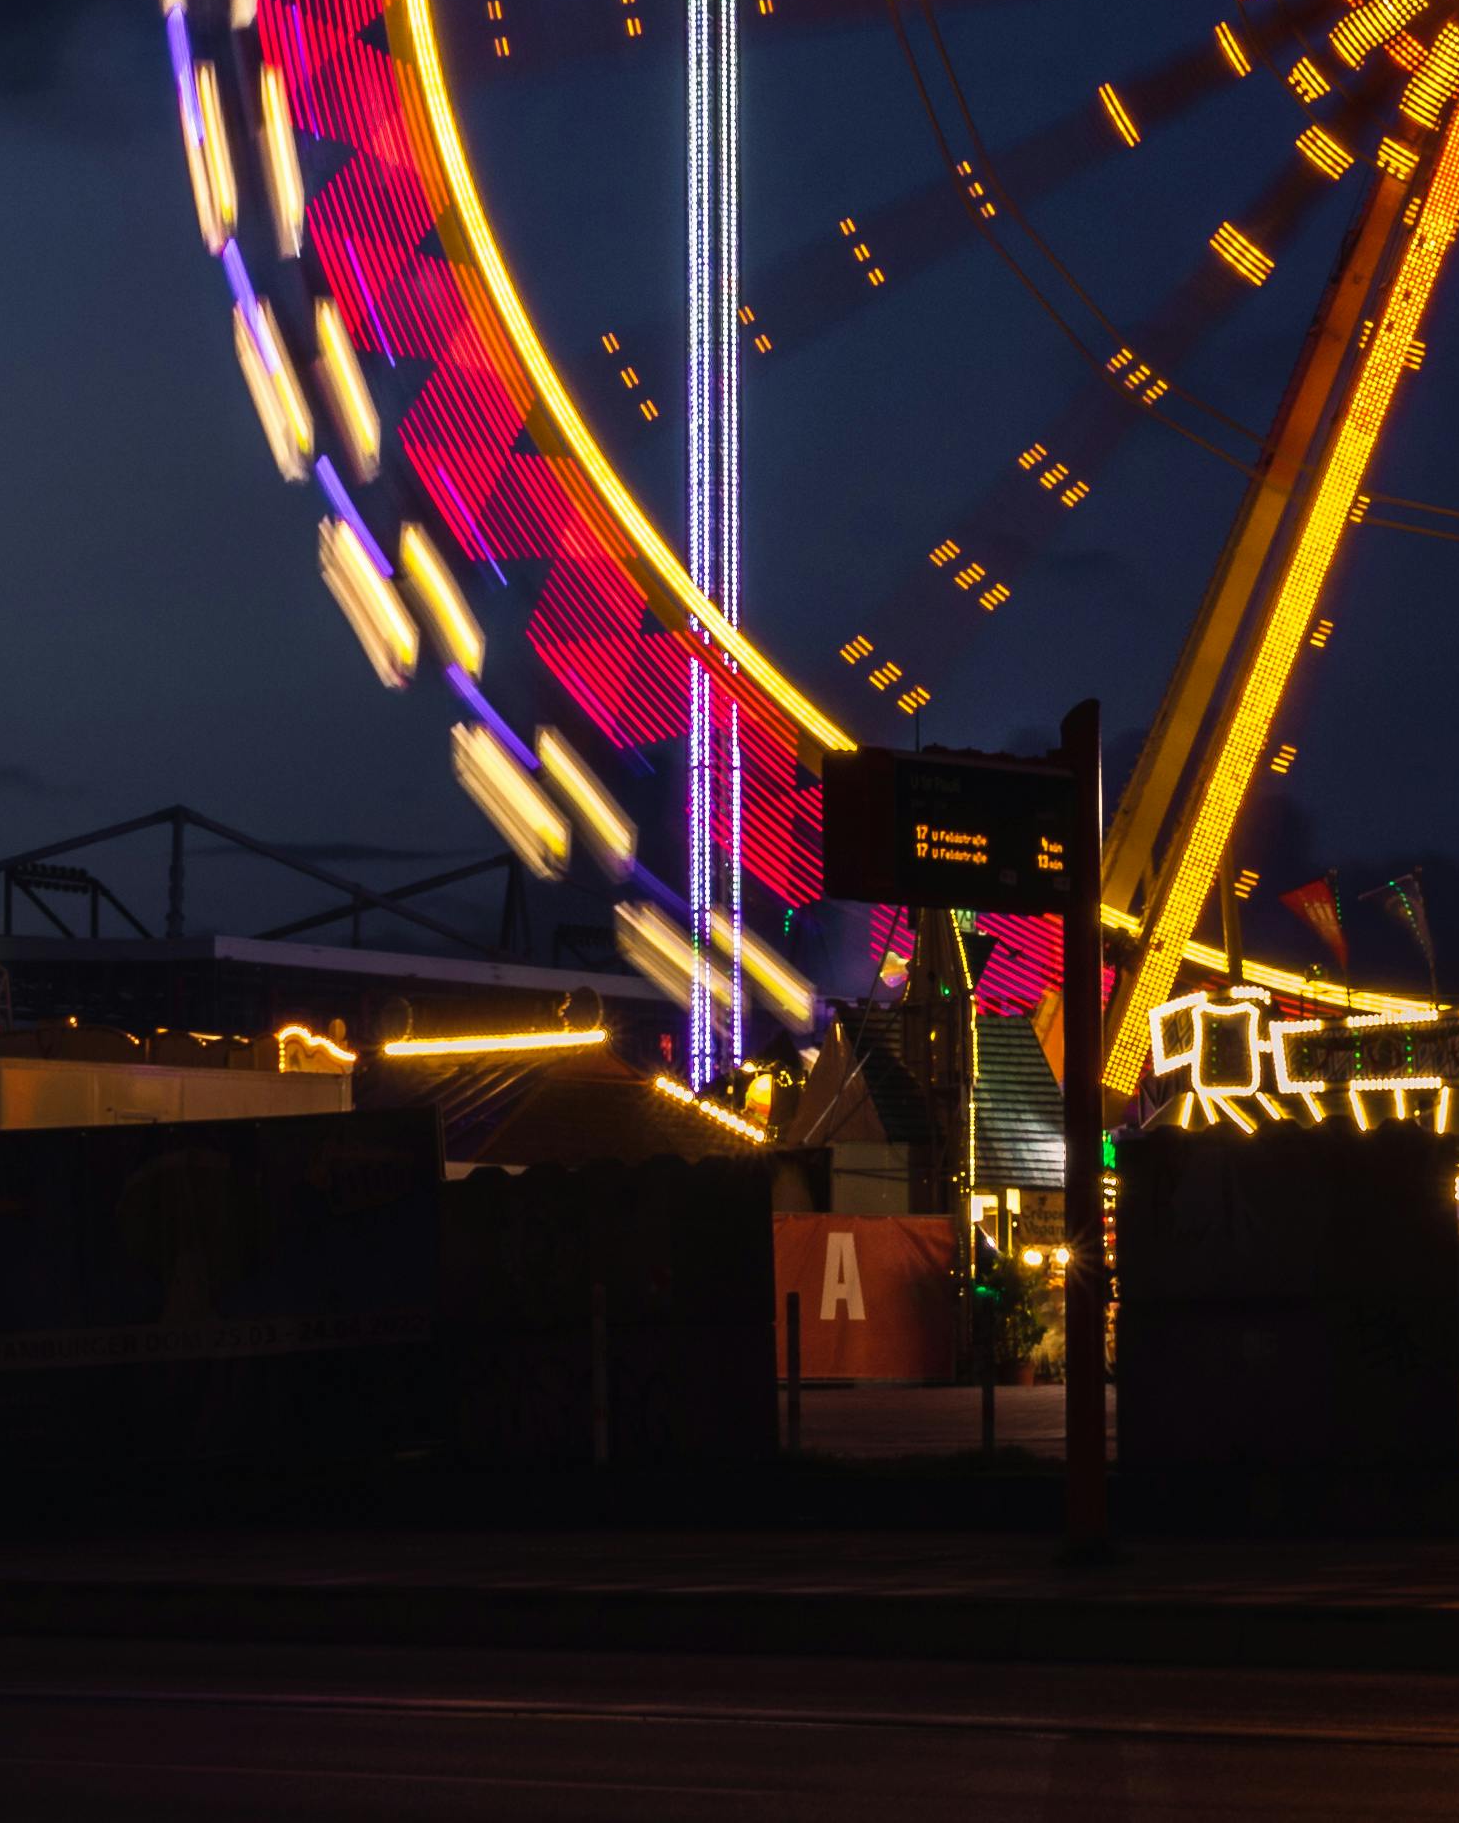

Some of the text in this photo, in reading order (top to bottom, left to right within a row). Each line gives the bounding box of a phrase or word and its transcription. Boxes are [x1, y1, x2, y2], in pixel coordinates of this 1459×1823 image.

[916, 824, 929, 840] 17
[916, 842, 929, 858] 17
[1037, 854, 1049, 869] 13
[819, 1231, 867, 1321] A
[143, 1329, 203, 1354] DOM
